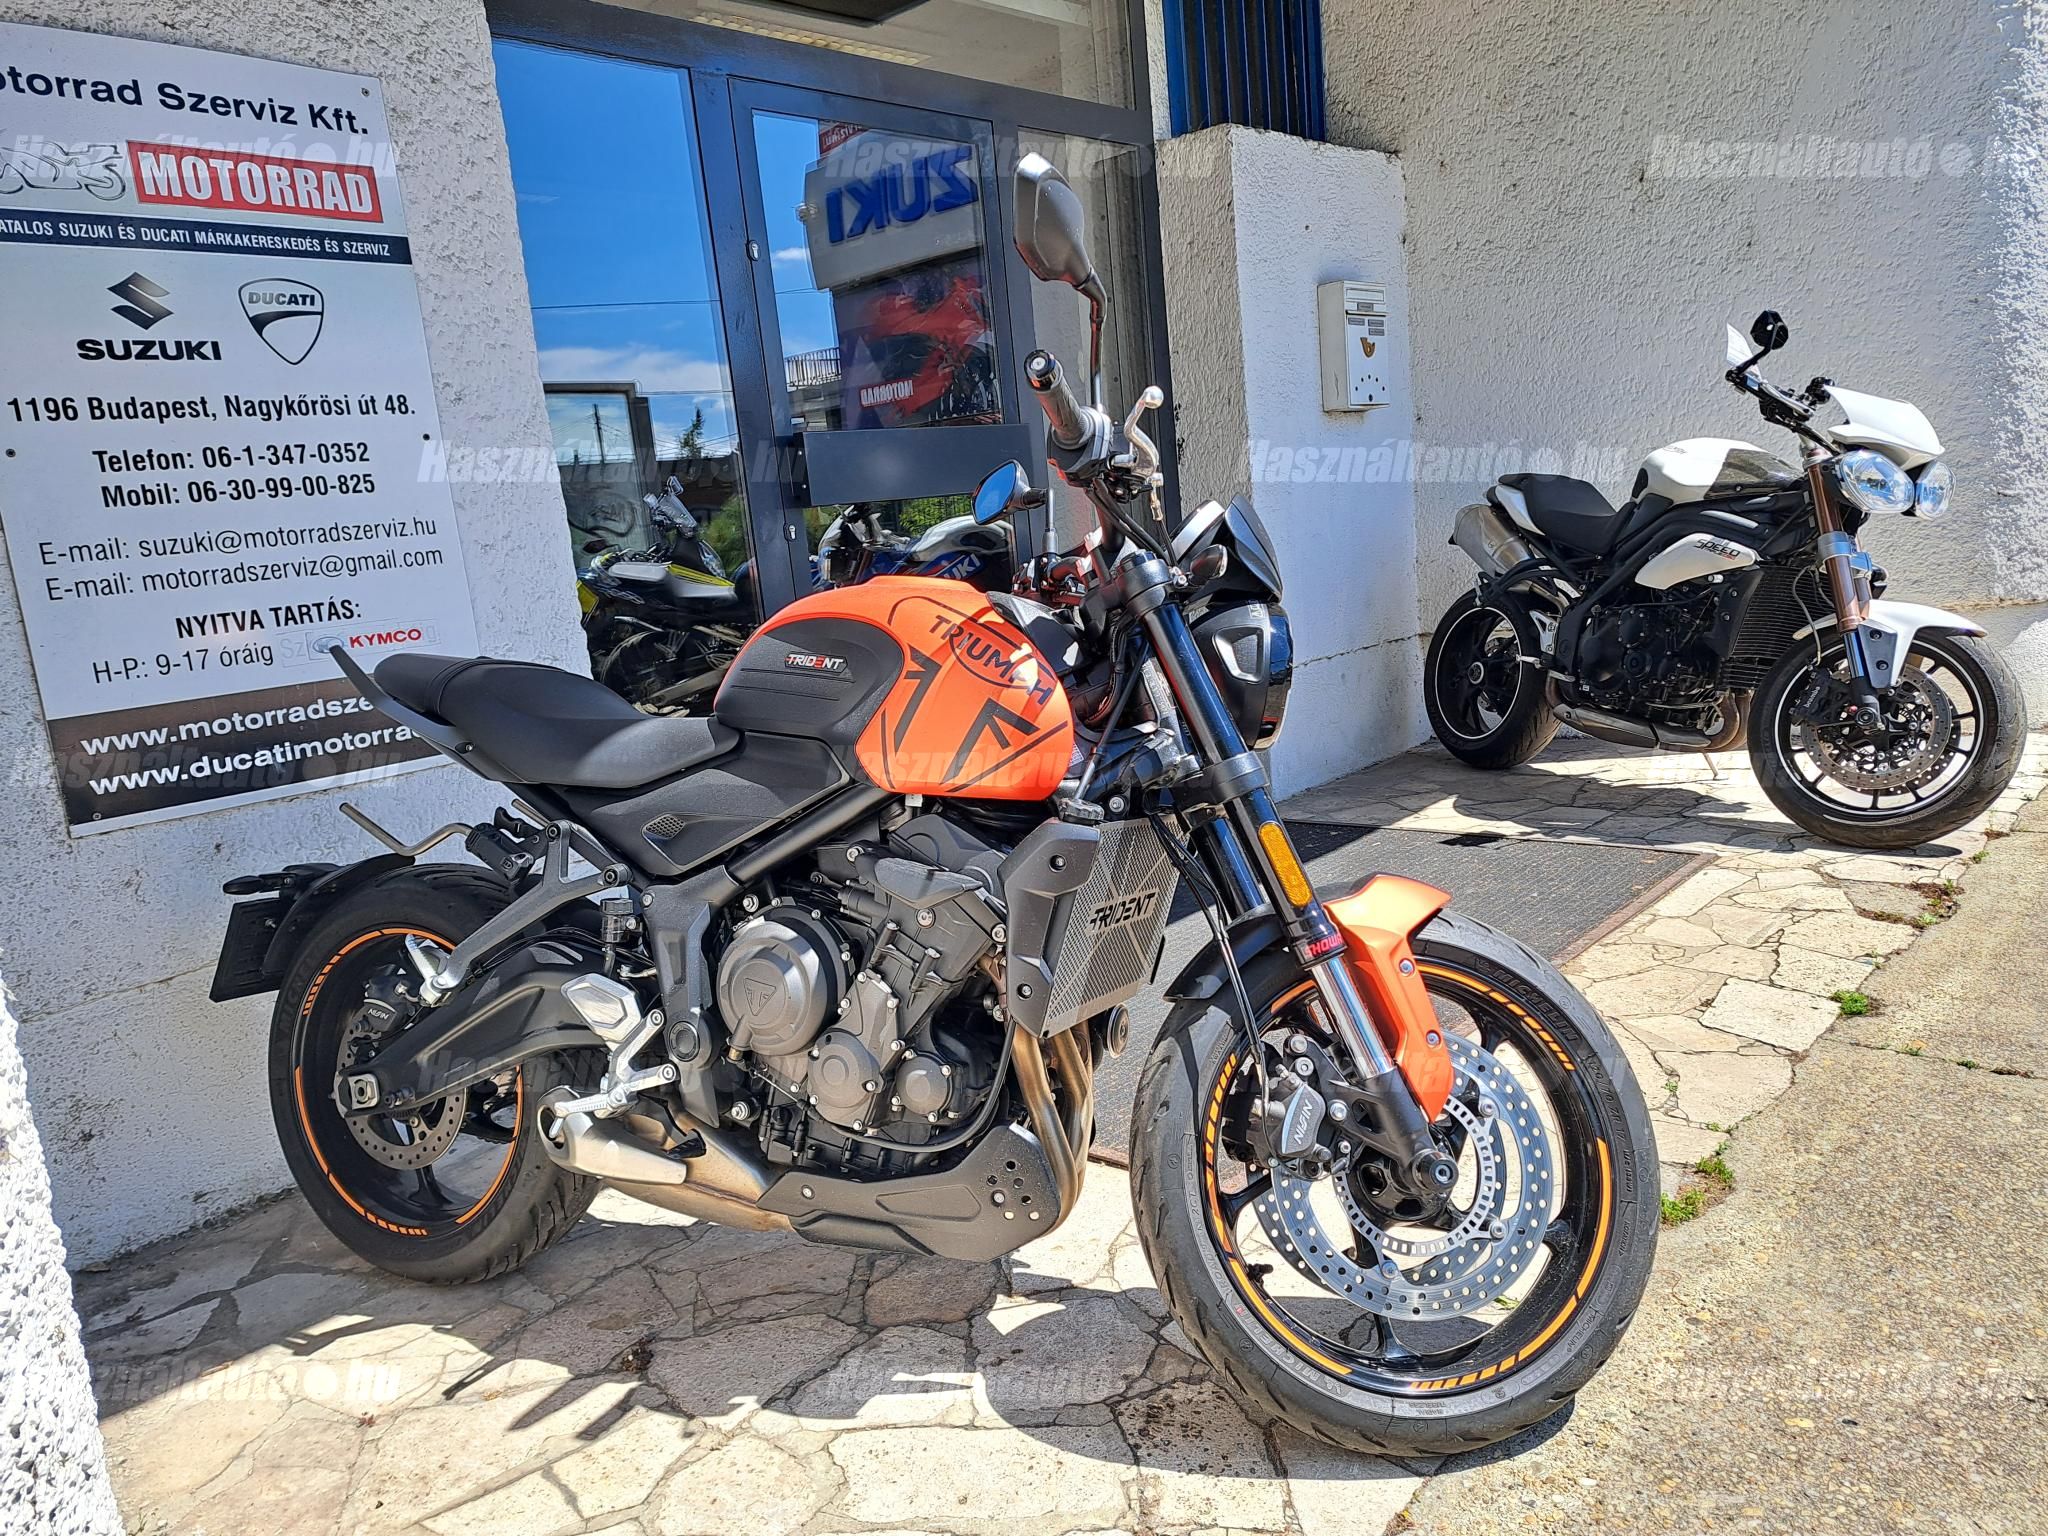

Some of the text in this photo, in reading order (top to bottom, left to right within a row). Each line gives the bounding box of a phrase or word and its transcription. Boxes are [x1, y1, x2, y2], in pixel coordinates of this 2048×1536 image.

[0, 65, 369, 134] torrad Szerviz Kft.
[137, 151, 374, 215] MOTORRAD
[58, 222, 114, 240] SUZUKI
[118, 220, 136, 240] ÉS
[141, 226, 190, 244] DUCATI
[195, 227, 321, 252] MÁRKAKERESKEDÉS
[325, 237, 341, 253] ÉS
[343, 240, 391, 257] SZERVIZ
[248, 292, 316, 307] DUCATI
[76, 339, 223, 361] SUZUKI
[8, 393, 416, 424] 1196 Budapest, Nagykőrösi út 48.
[92, 442, 371, 473] Telefon: 06-1-347-0352
[101, 473, 376, 508] Mobil: 06-30-99-00-825
[40, 516, 437, 566] E-mail: suzuki@motorradszerviz.hu
[1692, 538, 1741, 557] SPEED
[45, 547, 444, 601] E-mail: motorradszerviz@gmail.com
[175, 598, 363, 640] NYITVA TARTÁS:
[349, 628, 422, 650] KYMCO
[156, 648, 210, 677] 9-17
[219, 642, 275, 668] óráig
[786, 653, 845, 671] TRIDENT
[89, 724, 422, 796] www.ducatimotorra
[1090, 892, 1157, 931] TRIDENT
[1236, 1304, 1321, 1384] MICHELIN
